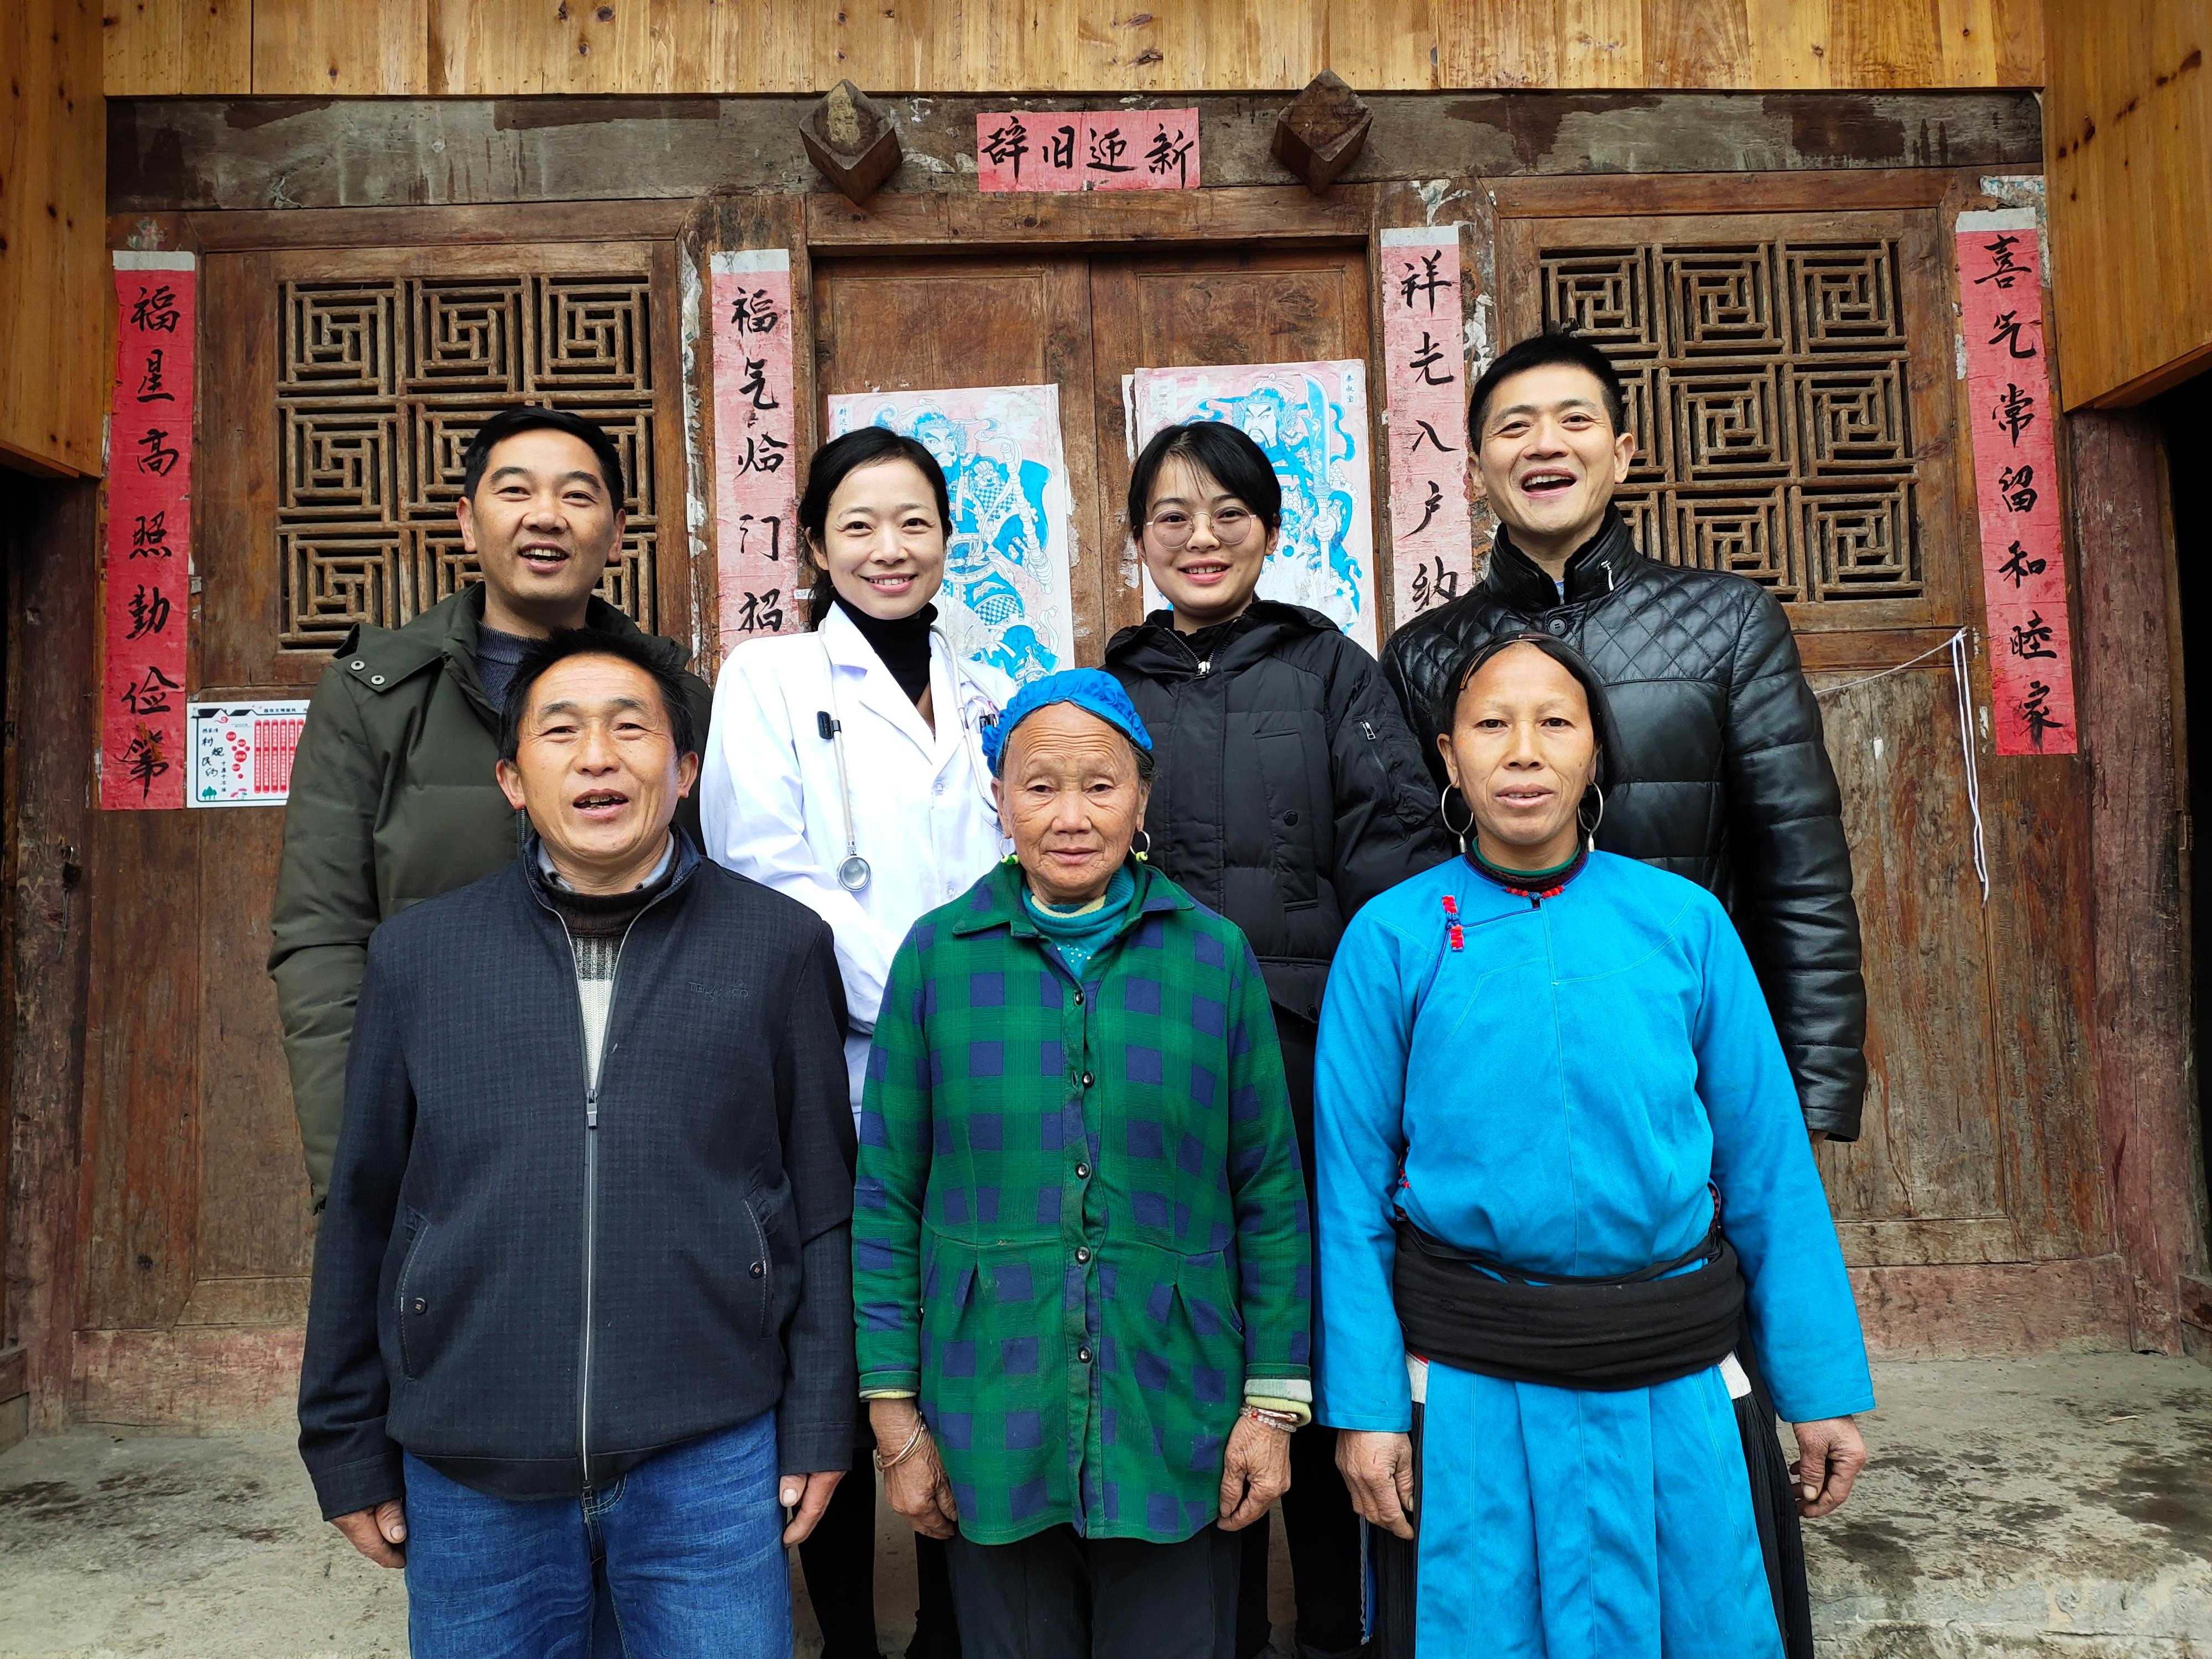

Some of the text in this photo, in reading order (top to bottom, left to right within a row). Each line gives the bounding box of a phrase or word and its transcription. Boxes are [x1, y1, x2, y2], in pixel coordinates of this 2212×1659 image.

[981, 116, 1194, 189] 辞旧迎新
[1345, 373, 1354, 403] 秦叔宝
[1398, 249, 1459, 612] 祥光入户纳
[1974, 234, 2064, 754] 喜气常留和睦家
